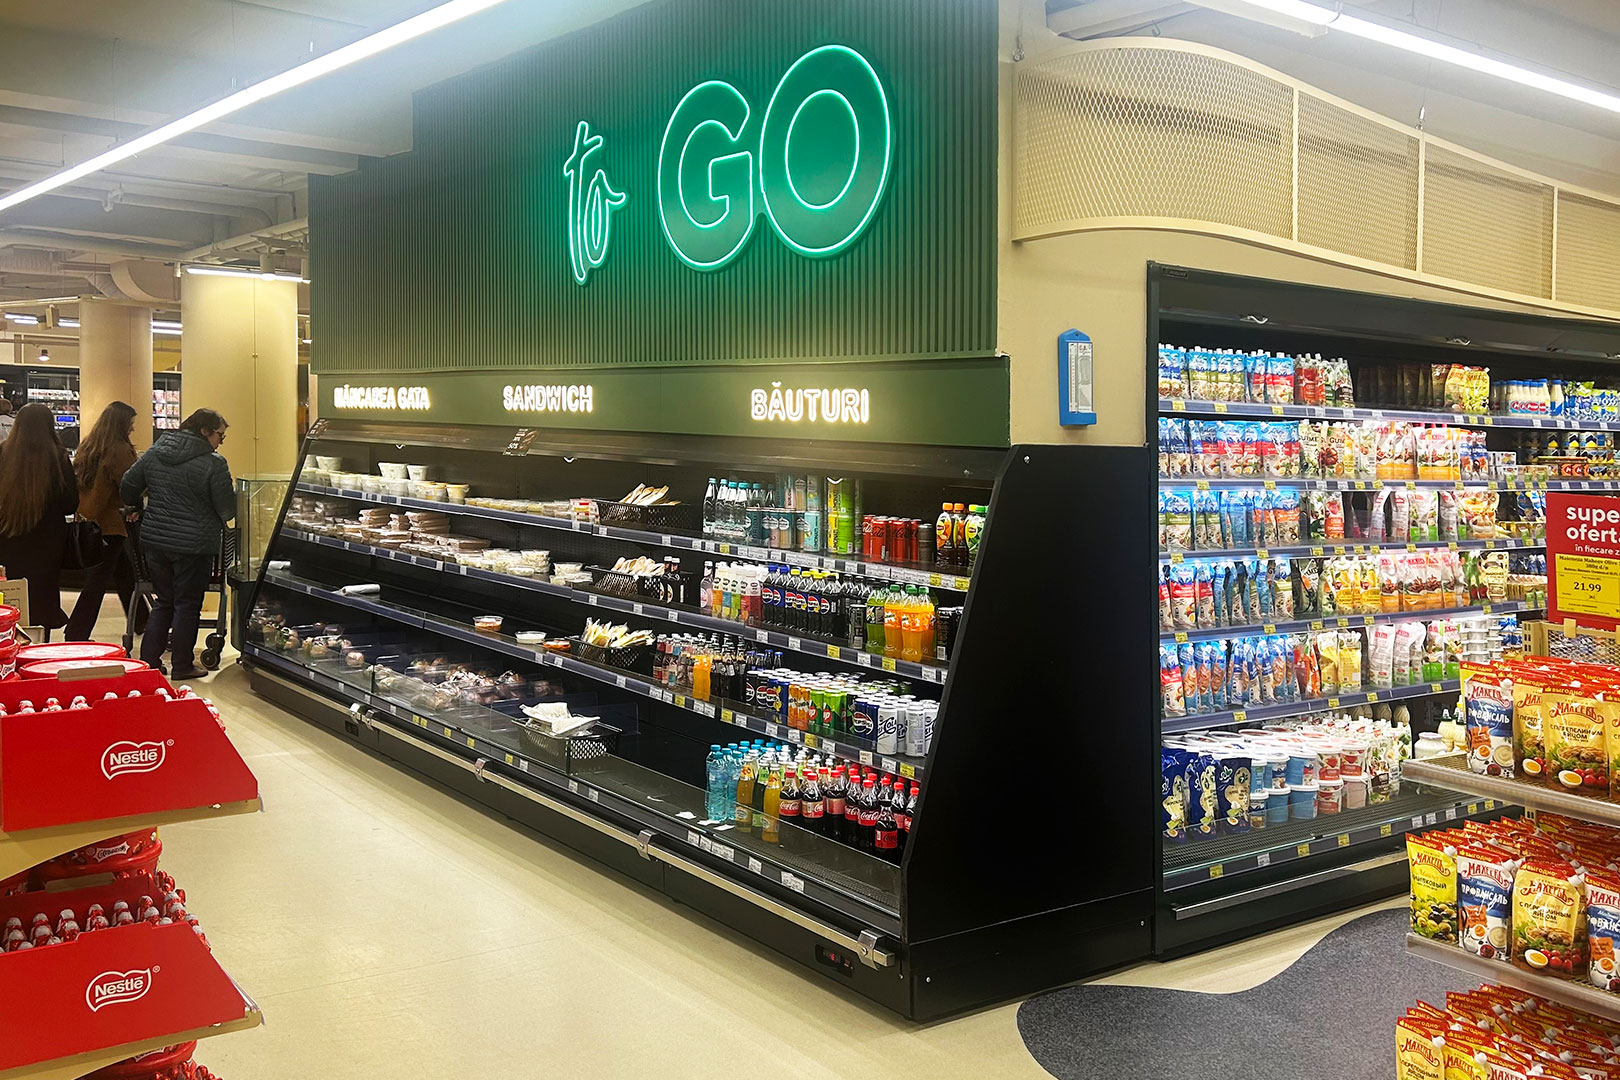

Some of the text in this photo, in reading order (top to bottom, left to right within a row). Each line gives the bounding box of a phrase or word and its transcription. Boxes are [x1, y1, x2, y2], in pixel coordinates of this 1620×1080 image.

[564, 44, 891, 284] to GO
[397, 386, 430, 410] GATA
[503, 385, 593, 412] SANDWICH
[751, 381, 870, 424] BĂUTURI
[1566, 523, 1620, 544] ofert
[1584, 544, 1613, 555] fiecare
[1573, 581, 1602, 593] 21.99
